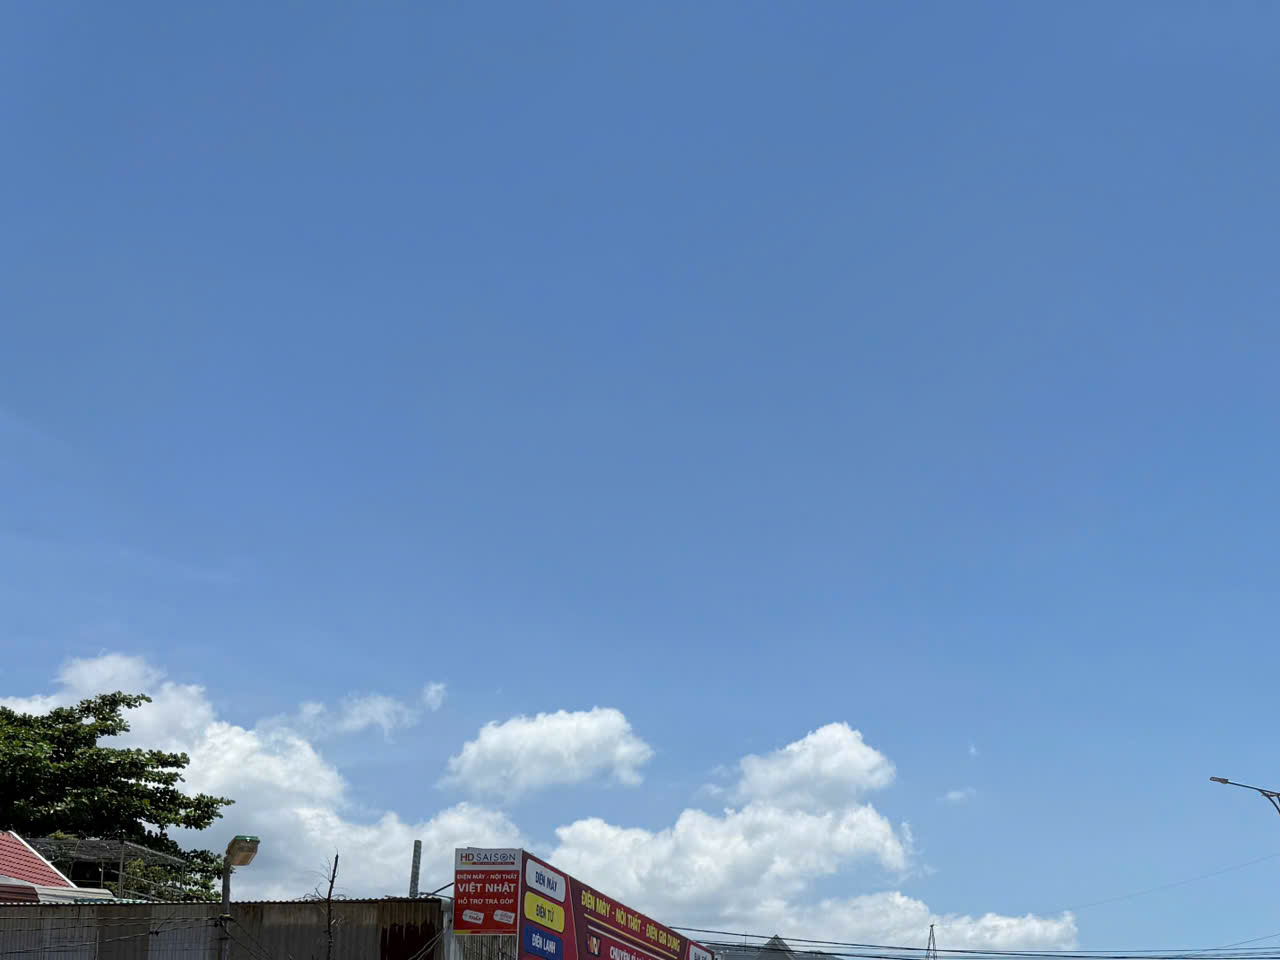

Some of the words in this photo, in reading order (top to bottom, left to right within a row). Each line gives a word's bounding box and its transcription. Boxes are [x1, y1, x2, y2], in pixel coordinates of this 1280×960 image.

[460, 853, 474, 861] HD
[476, 853, 516, 861] SAISON
[458, 881, 483, 895] VIỆT
[485, 881, 517, 895] NHẬT
[457, 896, 468, 905] HỖ
[499, 897, 514, 905] GÓP
[581, 889, 595, 912] ĐIỆN
[615, 907, 627, 928] NỘI
